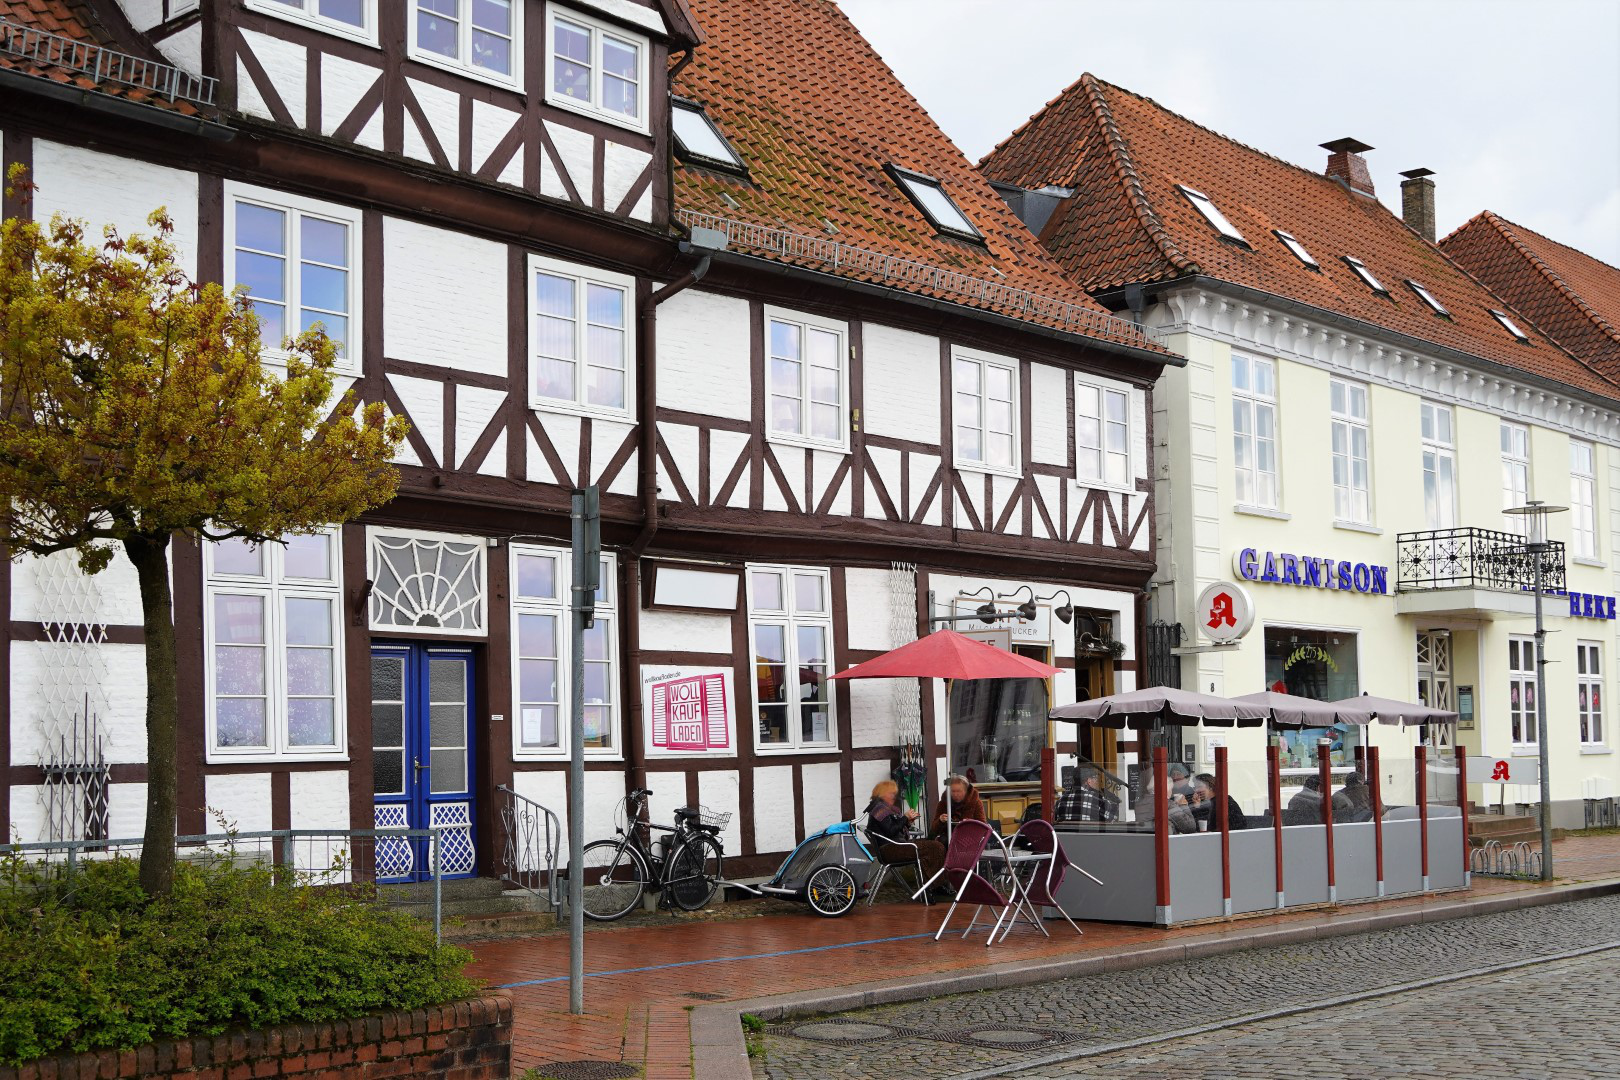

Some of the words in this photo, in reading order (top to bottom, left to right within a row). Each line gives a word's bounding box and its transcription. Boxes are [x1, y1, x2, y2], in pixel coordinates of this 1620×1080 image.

[1239, 547, 1388, 595] GARNISON
[1012, 627, 1038, 636] UCKER
[671, 683, 699, 701] WOLL
[1210, 682, 1215, 693] 8
[672, 703, 700, 720] KAUF
[673, 725, 701, 741] LADEN
